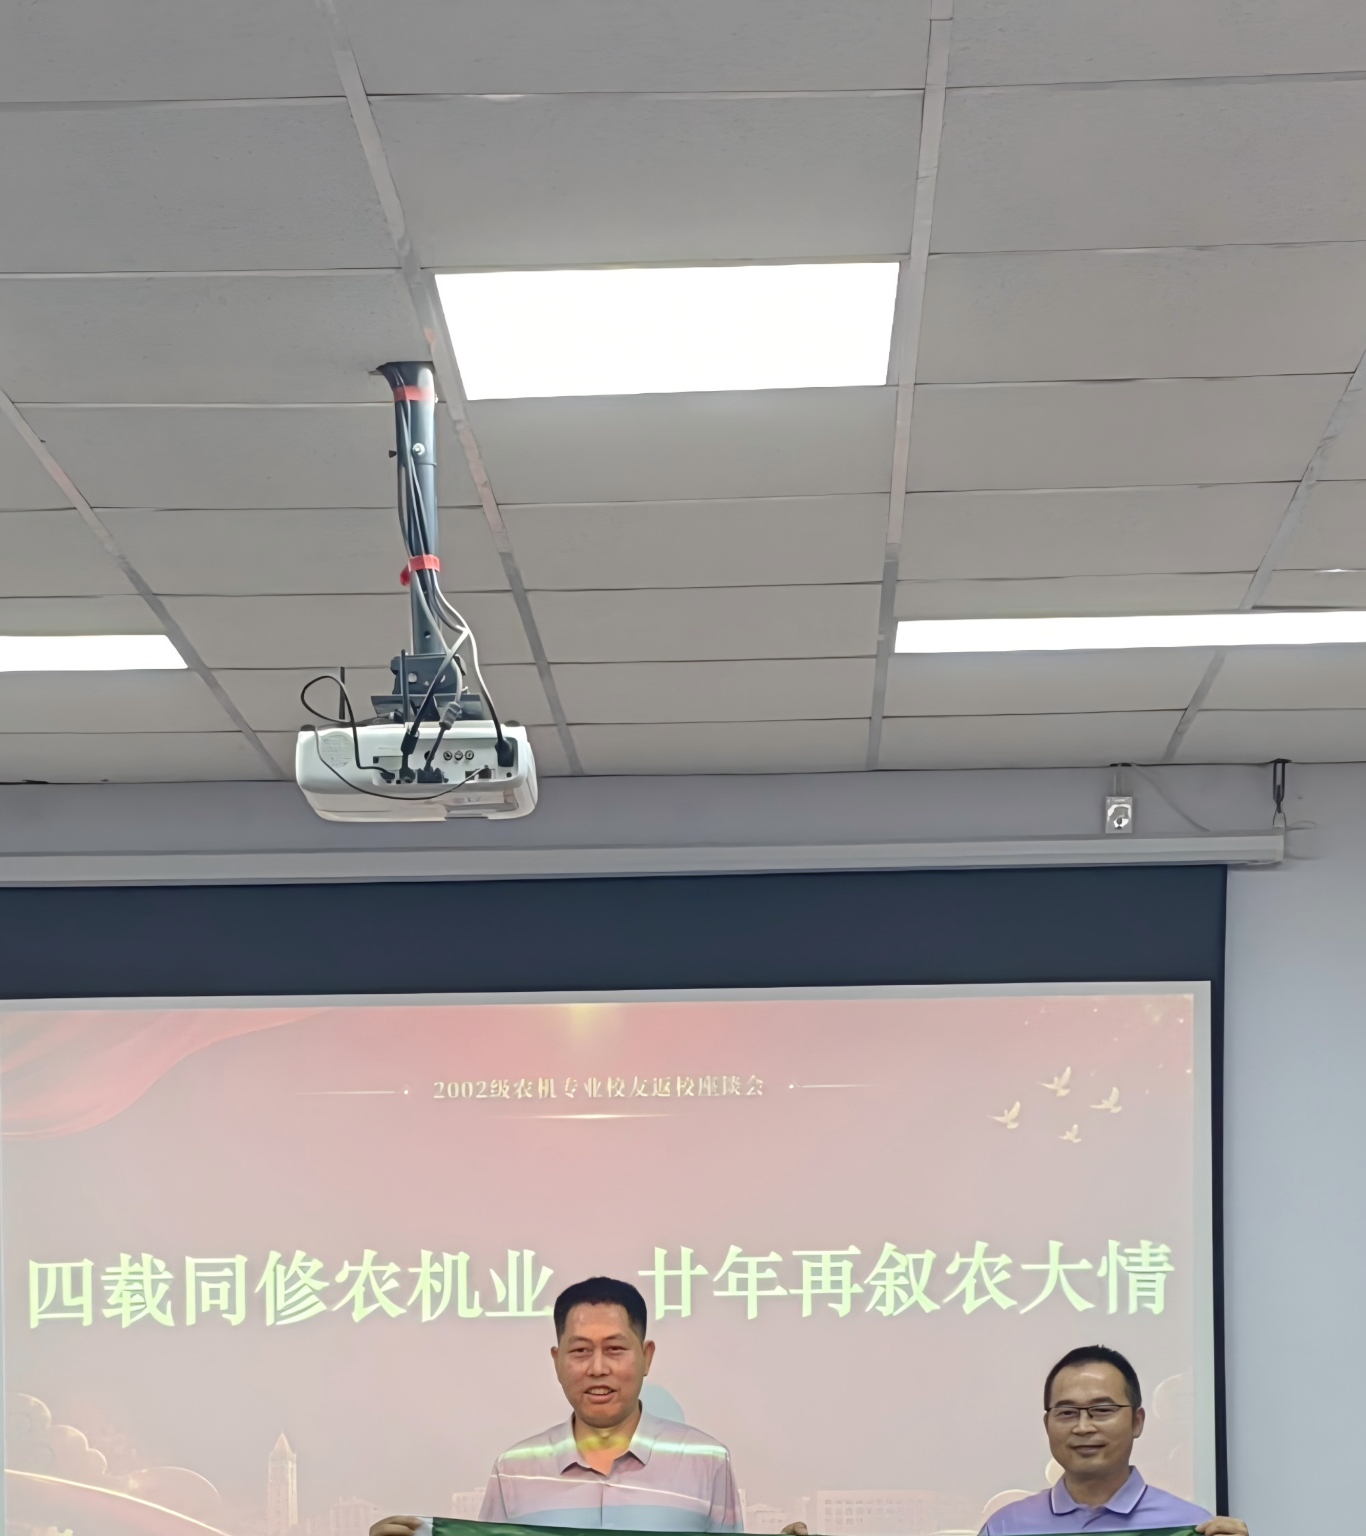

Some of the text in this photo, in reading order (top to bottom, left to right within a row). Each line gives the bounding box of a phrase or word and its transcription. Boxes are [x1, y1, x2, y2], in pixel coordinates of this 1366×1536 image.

[432, 1074, 764, 1100] 2002级农机专业校友返校座谈会
[28, 1238, 1176, 1329] 四载同修农机业 廿年再叙农大情
